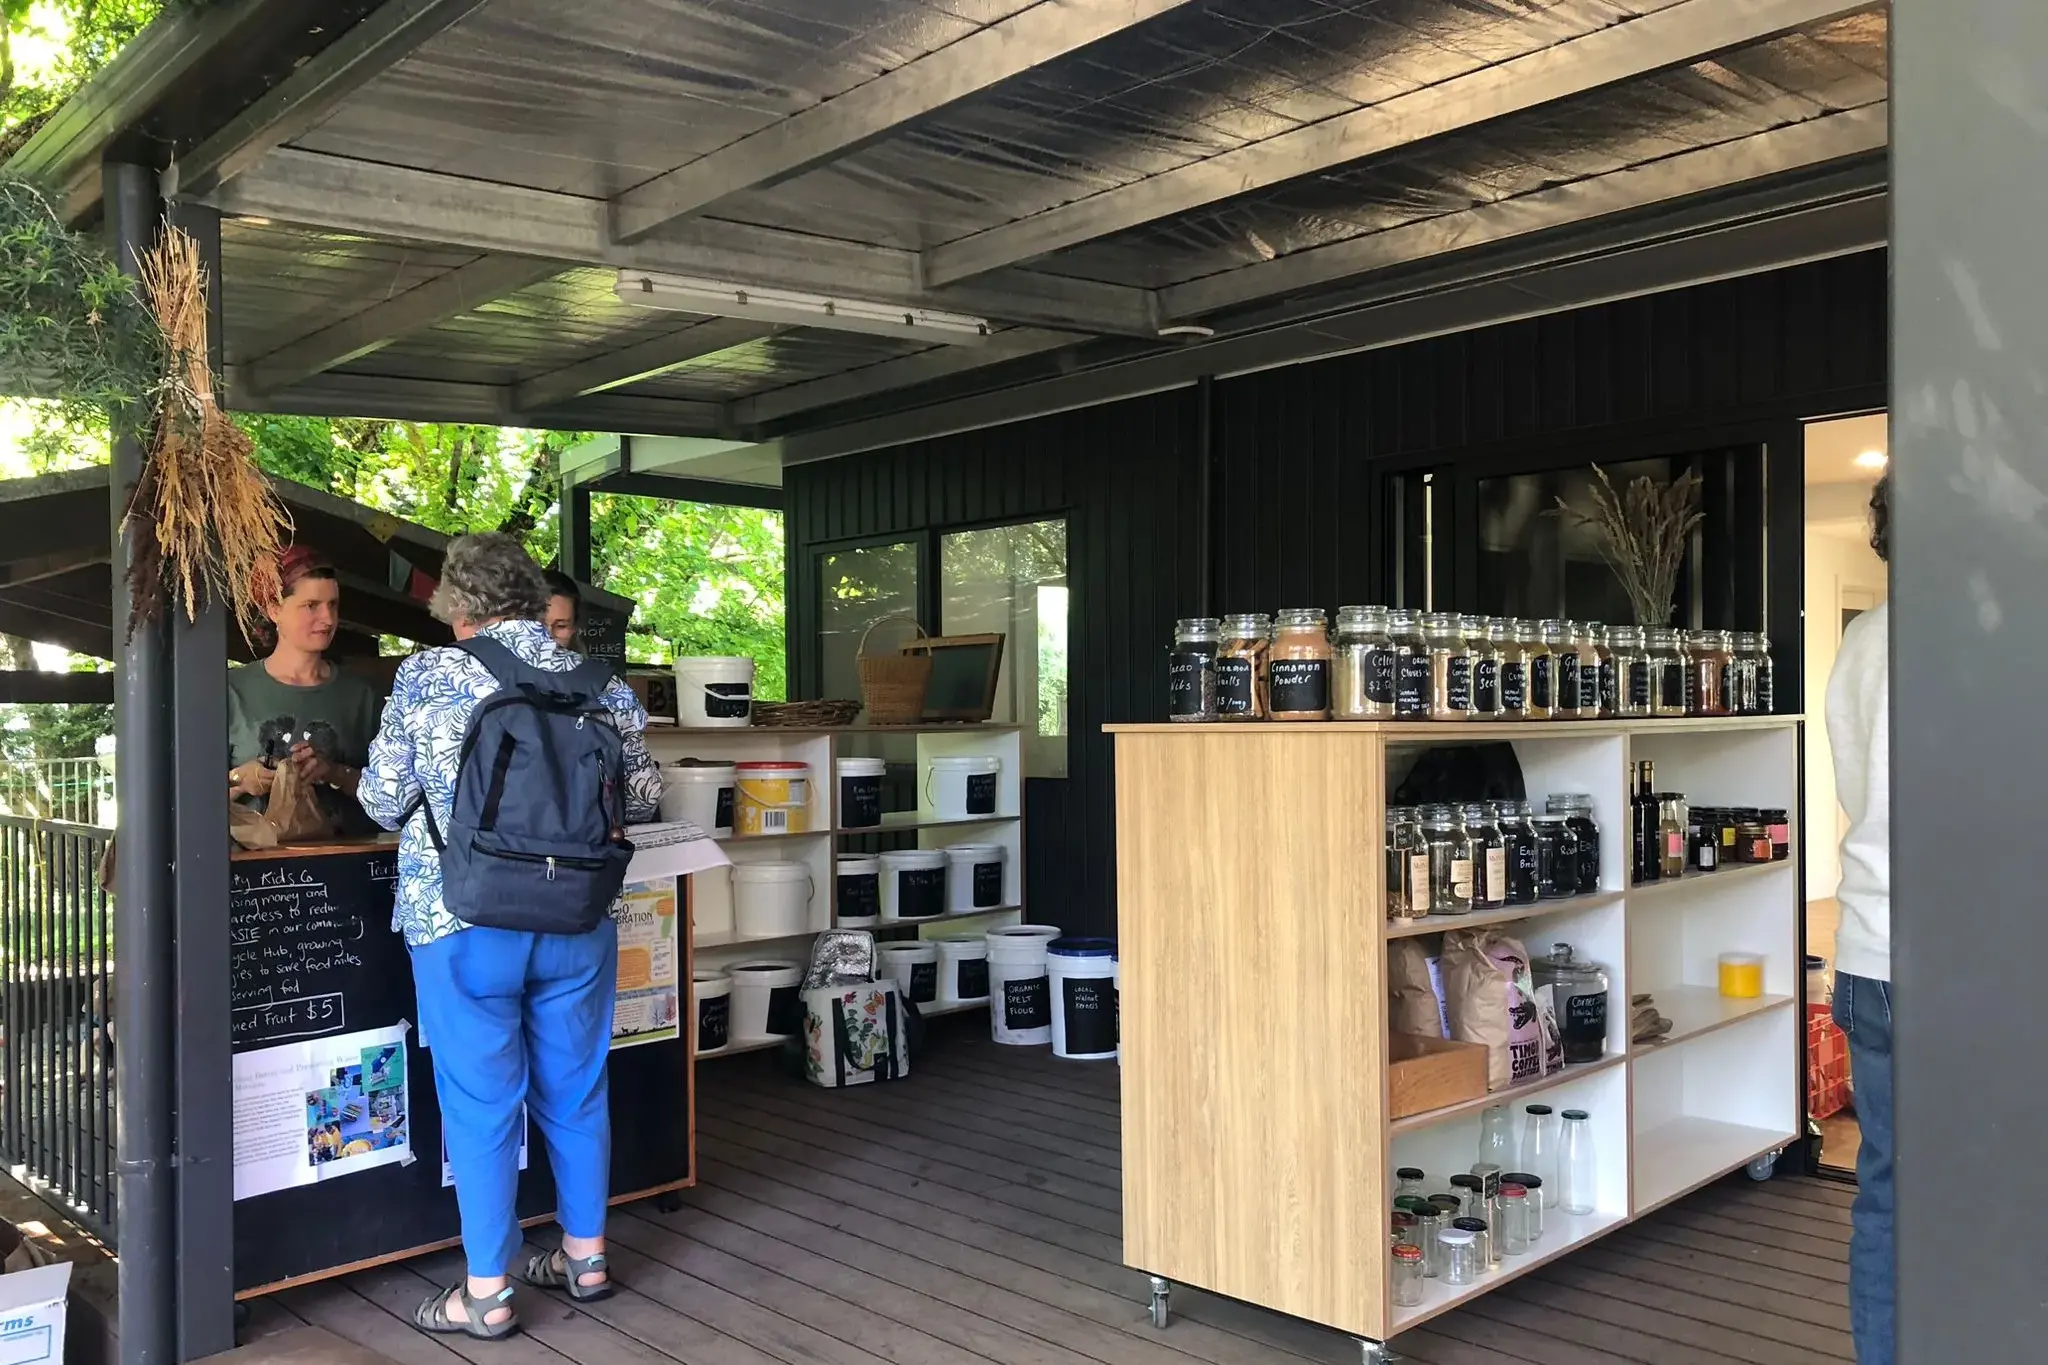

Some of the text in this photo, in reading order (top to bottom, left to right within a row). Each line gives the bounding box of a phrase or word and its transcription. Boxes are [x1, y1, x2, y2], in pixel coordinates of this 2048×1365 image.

[588, 642, 621, 653] HERE
[1271, 662, 1321, 674] Cinnamon
[1274, 674, 1312, 686] Powder
[261, 867, 295, 887] Kids
[262, 892, 300, 912] money
[306, 885, 328, 898] and
[289, 905, 300, 919] to
[283, 923, 302, 934] our
[297, 938, 344, 962] growing
[260, 964, 270, 976] to
[276, 961, 300, 974] save
[306, 957, 331, 974] food
[1008, 984, 1040, 994] ORGANIC
[1007, 995, 1033, 1004] SPELT
[265, 1006, 298, 1026] Fruit
[307, 998, 333, 1020] $5
[1009, 1006, 1035, 1016] FLOUR
